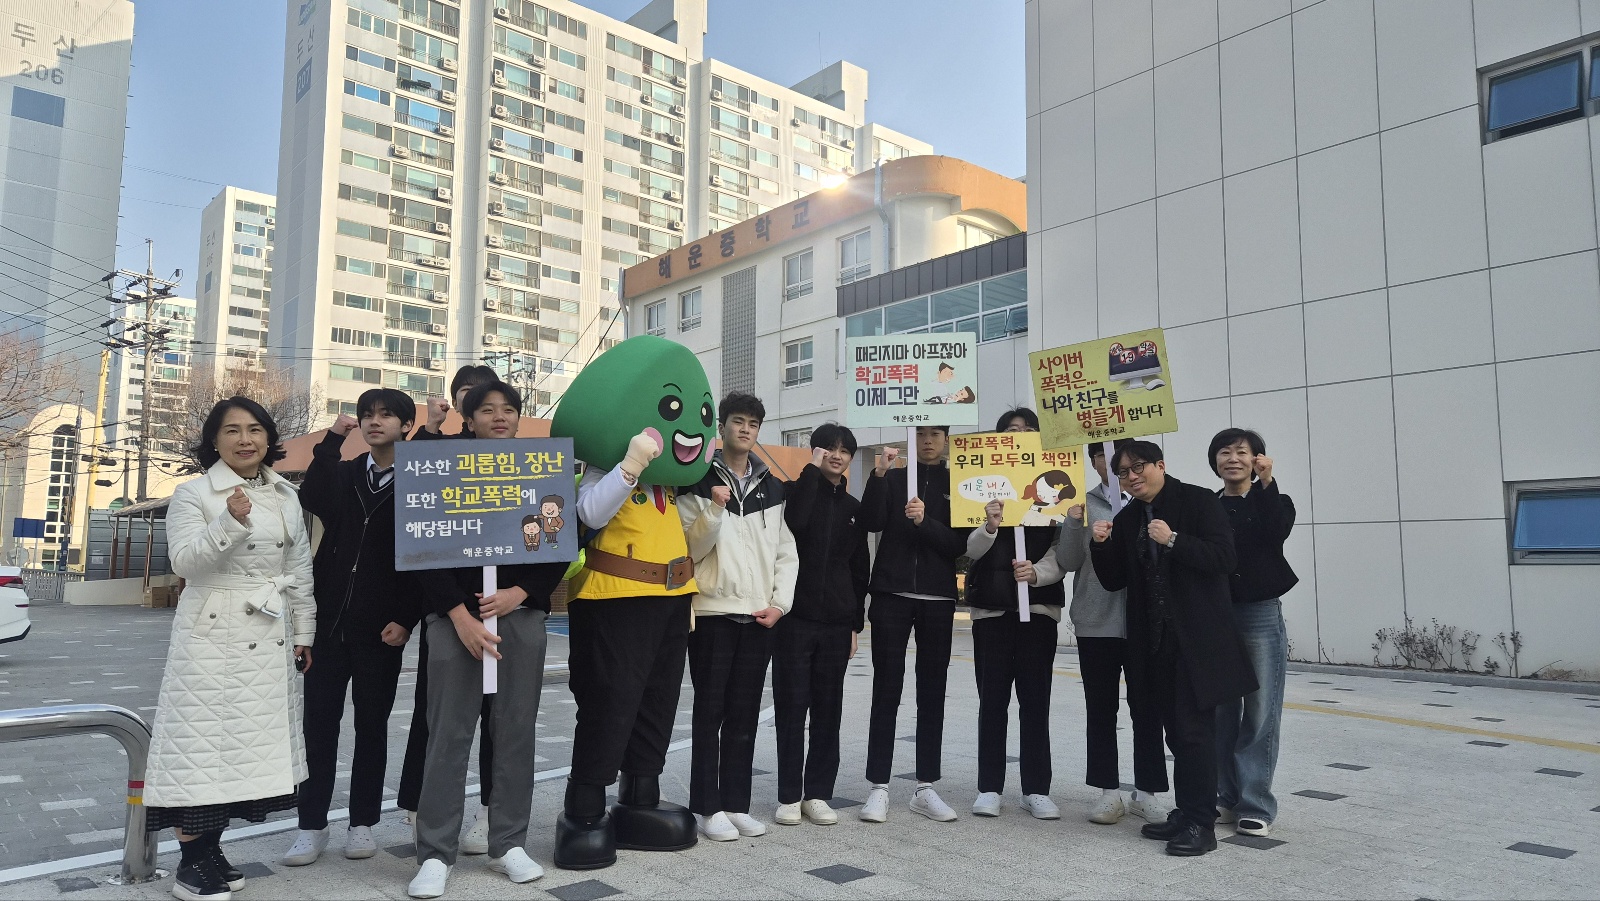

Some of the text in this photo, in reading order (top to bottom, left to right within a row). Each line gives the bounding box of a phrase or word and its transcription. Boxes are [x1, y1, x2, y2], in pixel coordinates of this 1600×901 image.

[19, 59, 64, 85] 206
[658, 200, 810, 279] 해운중학교
[855, 342, 967, 362] 때리지마 아프잖아
[1037, 351, 1084, 374] 사이버
[1122, 351, 1134, 363] 19
[855, 364, 919, 385] 학교폭력
[1040, 370, 1098, 393] 폭력은...
[855, 386, 919, 407] 이제그만
[1042, 387, 1119, 414] 나와 친구를
[893, 415, 930, 423] 해운중학교
[1076, 403, 1163, 429] 병들게 합니다
[1087, 426, 1126, 439] 해운중학교
[954, 436, 1020, 452] 학교폭력,
[404, 451, 565, 476] 사소한 괴롭힘, 장난
[954, 451, 1078, 469] 우리 모두의 책임!
[405, 484, 537, 509] 또한 학교폭력에
[405, 518, 483, 538] 해당됩니다
[462, 545, 514, 557] 해운중학교
